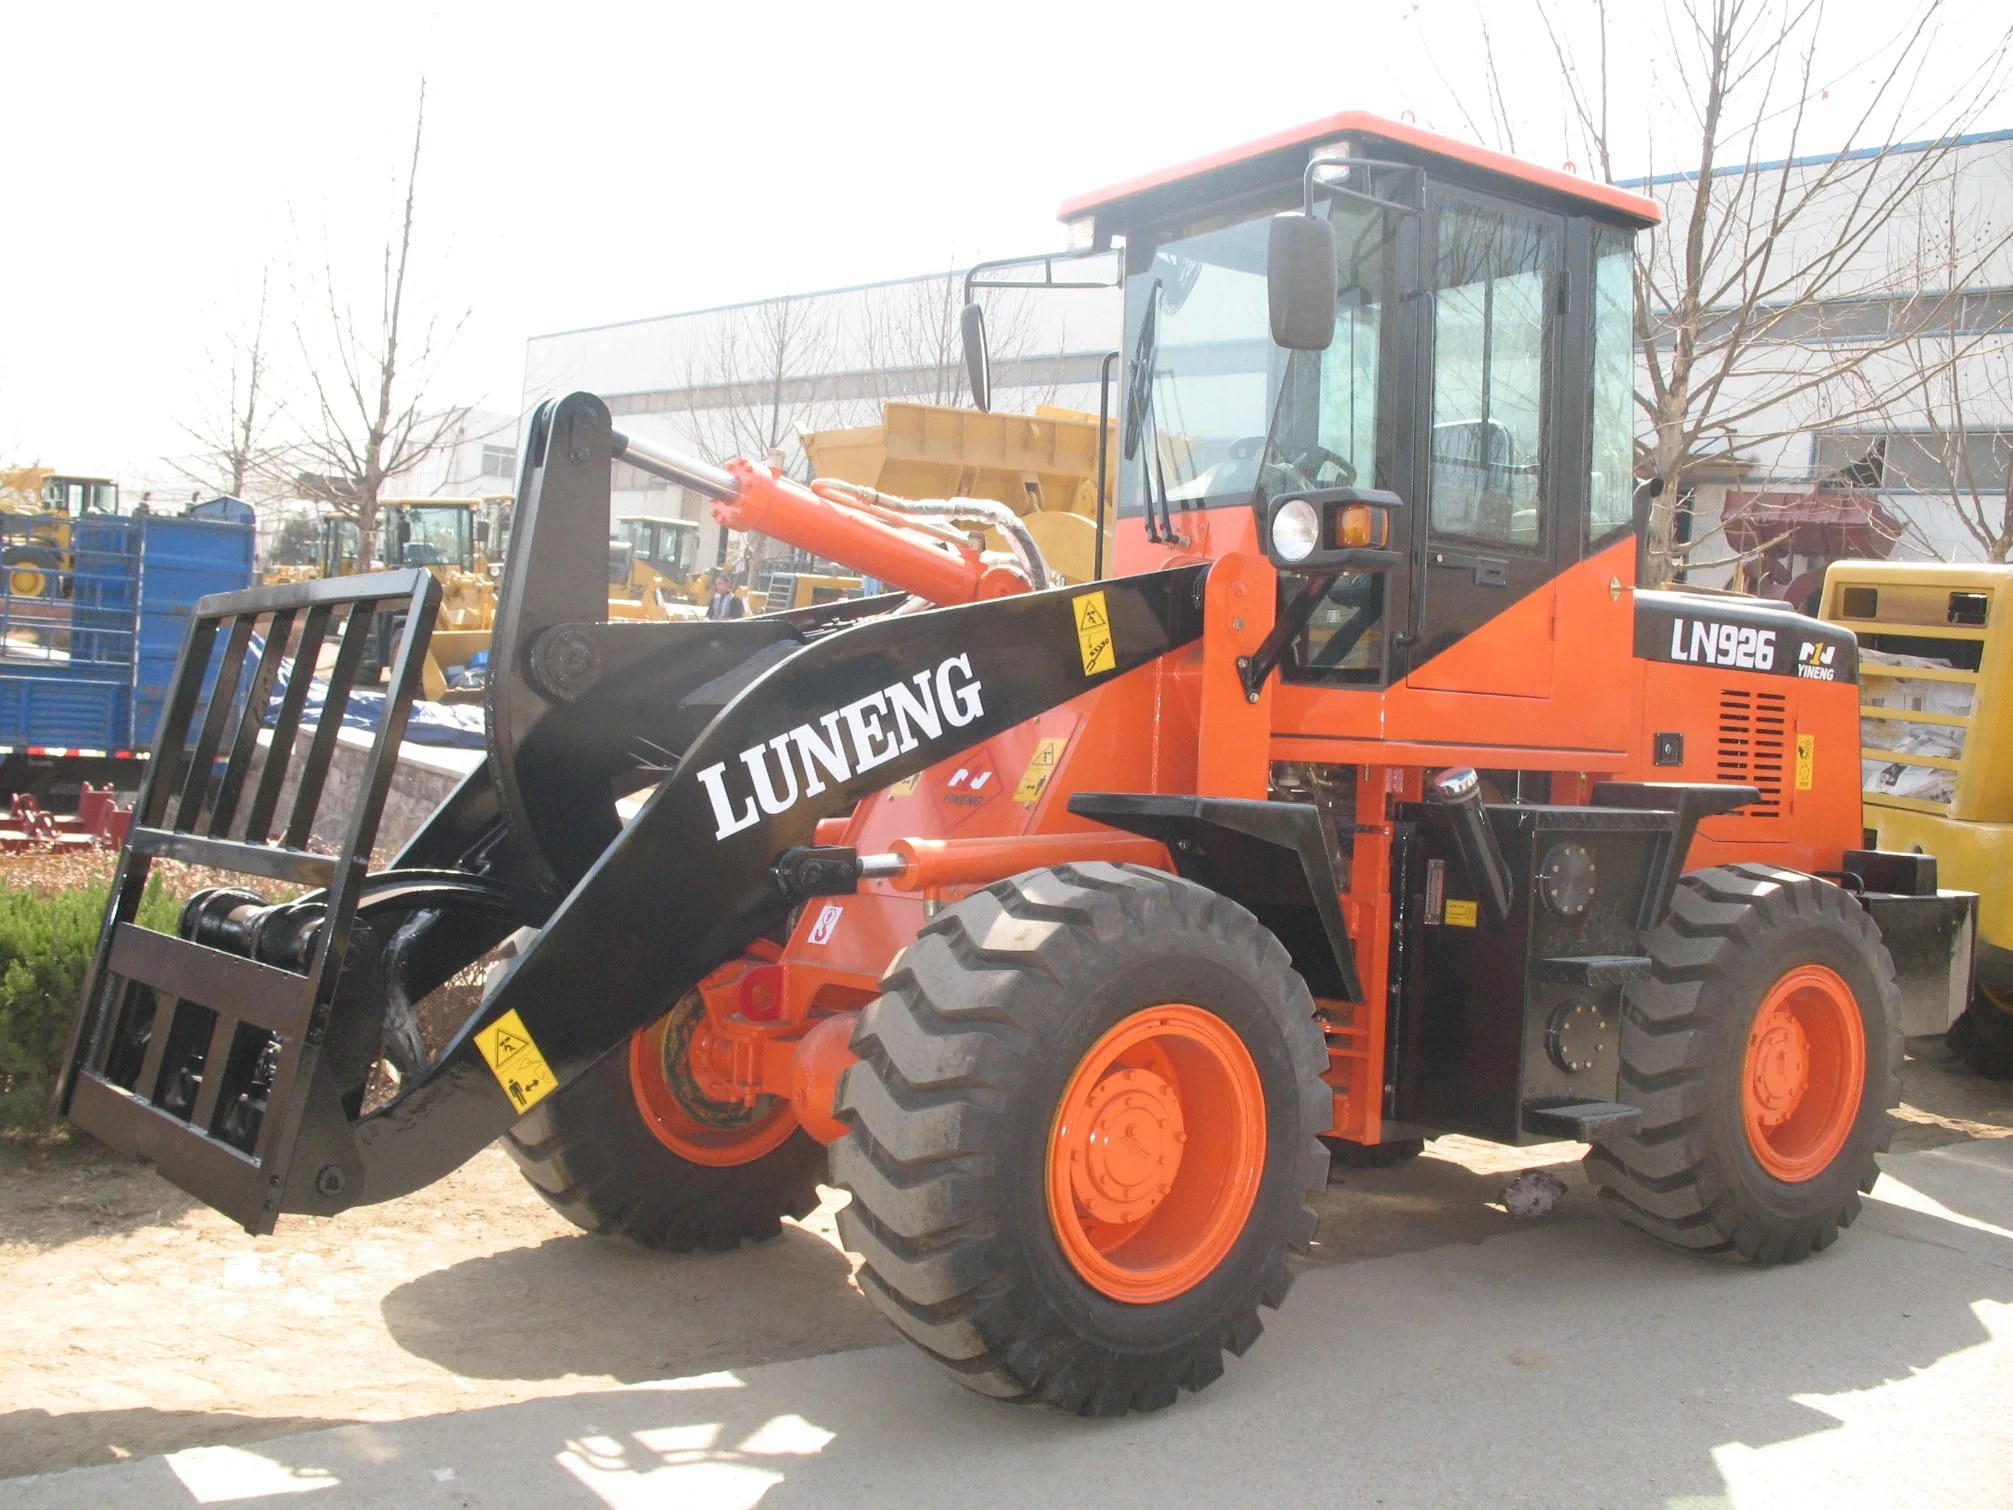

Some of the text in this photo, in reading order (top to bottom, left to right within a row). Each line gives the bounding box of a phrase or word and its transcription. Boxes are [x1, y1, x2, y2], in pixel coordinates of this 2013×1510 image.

[1671, 618, 1776, 670] LN926
[1797, 663, 1835, 681] YINENG
[696, 653, 985, 841] LUNENG
